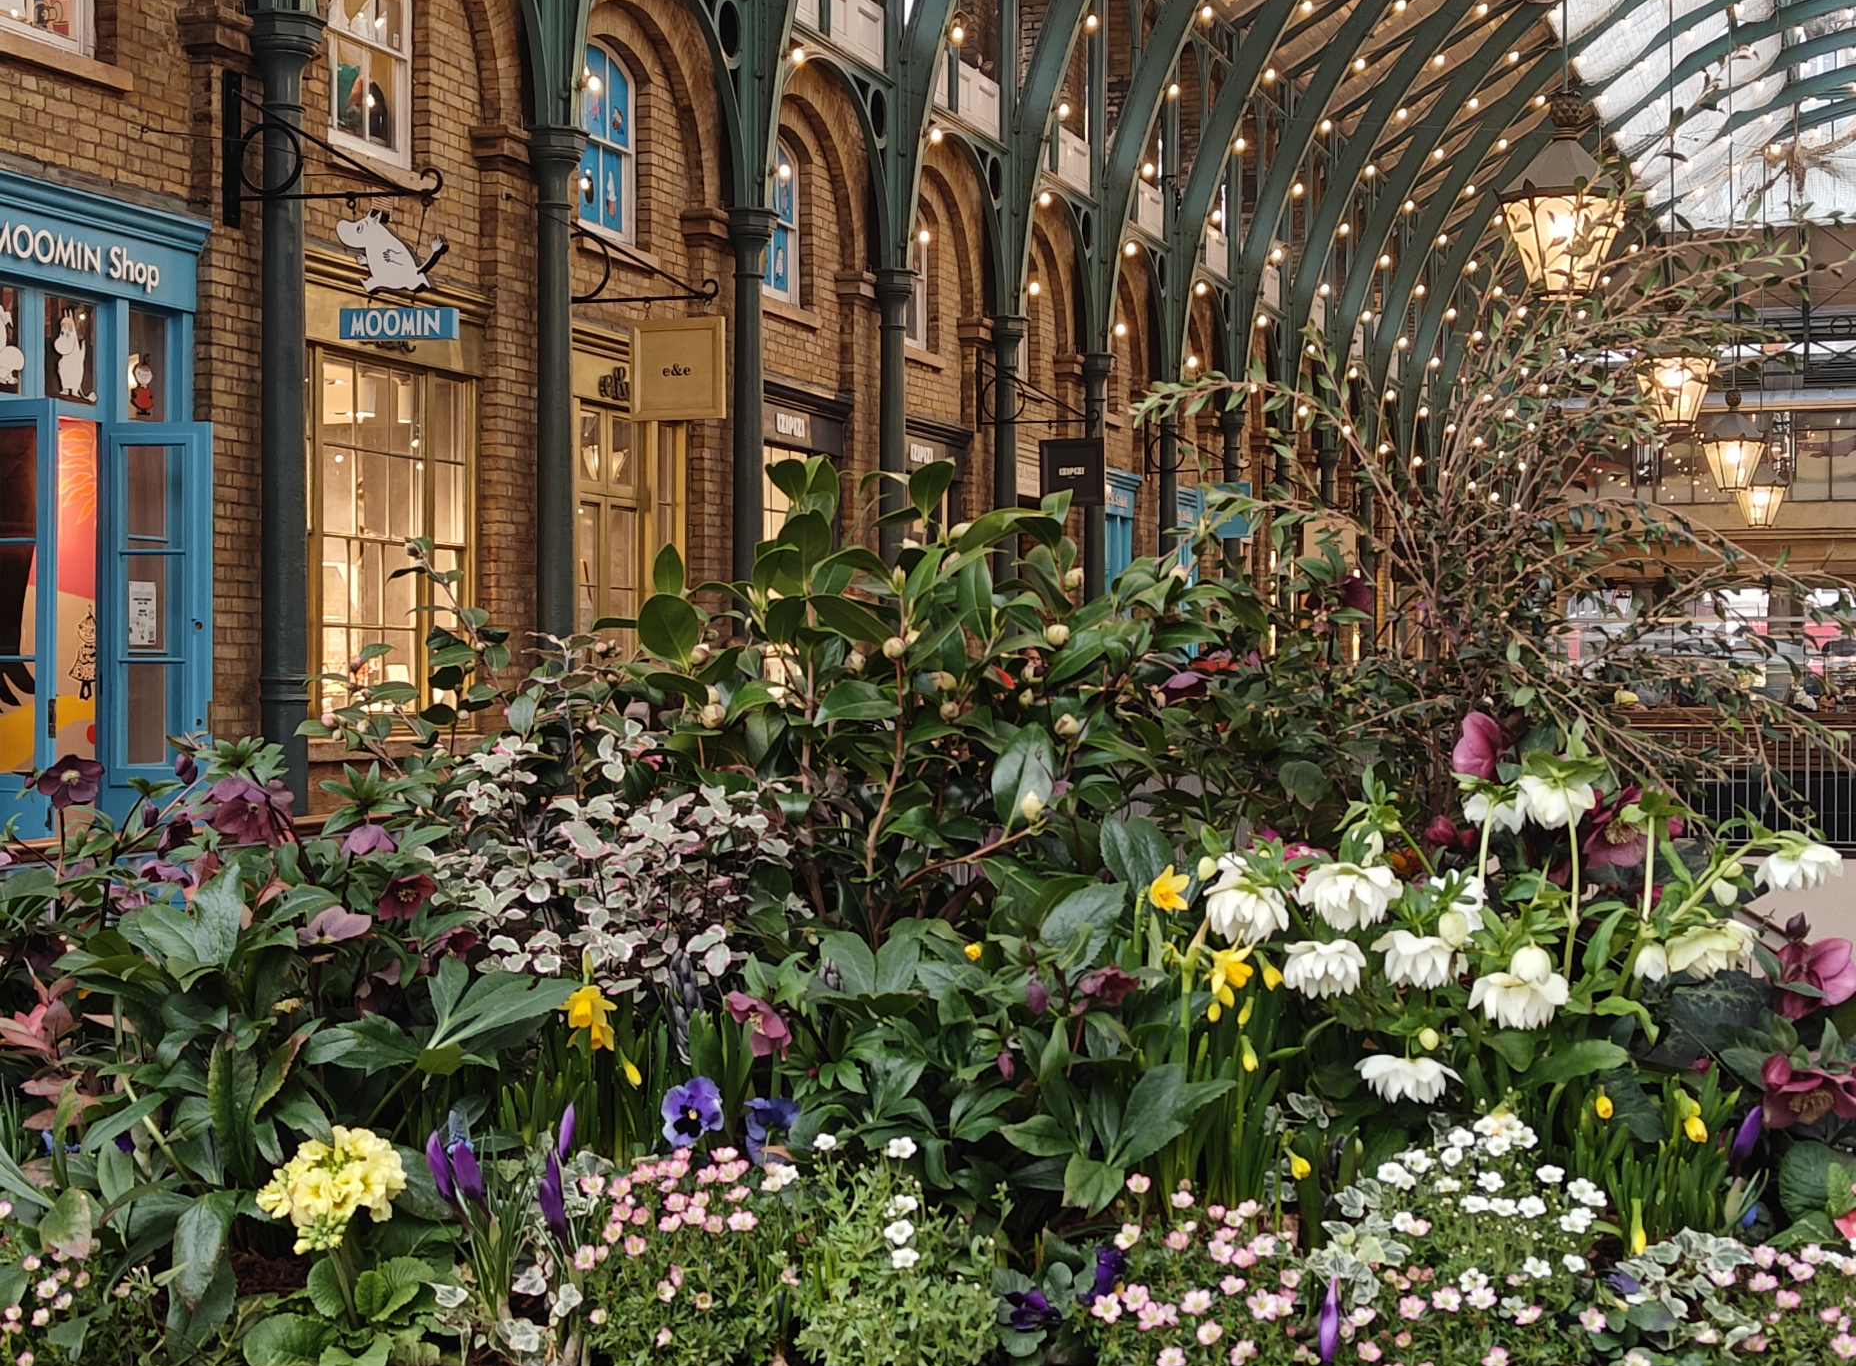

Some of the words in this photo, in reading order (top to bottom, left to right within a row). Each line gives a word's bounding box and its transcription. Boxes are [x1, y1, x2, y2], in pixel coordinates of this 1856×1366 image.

[109, 246, 160, 294] Shop
[350, 309, 440, 337] MOOMIN
[662, 363, 691, 377] e&e
